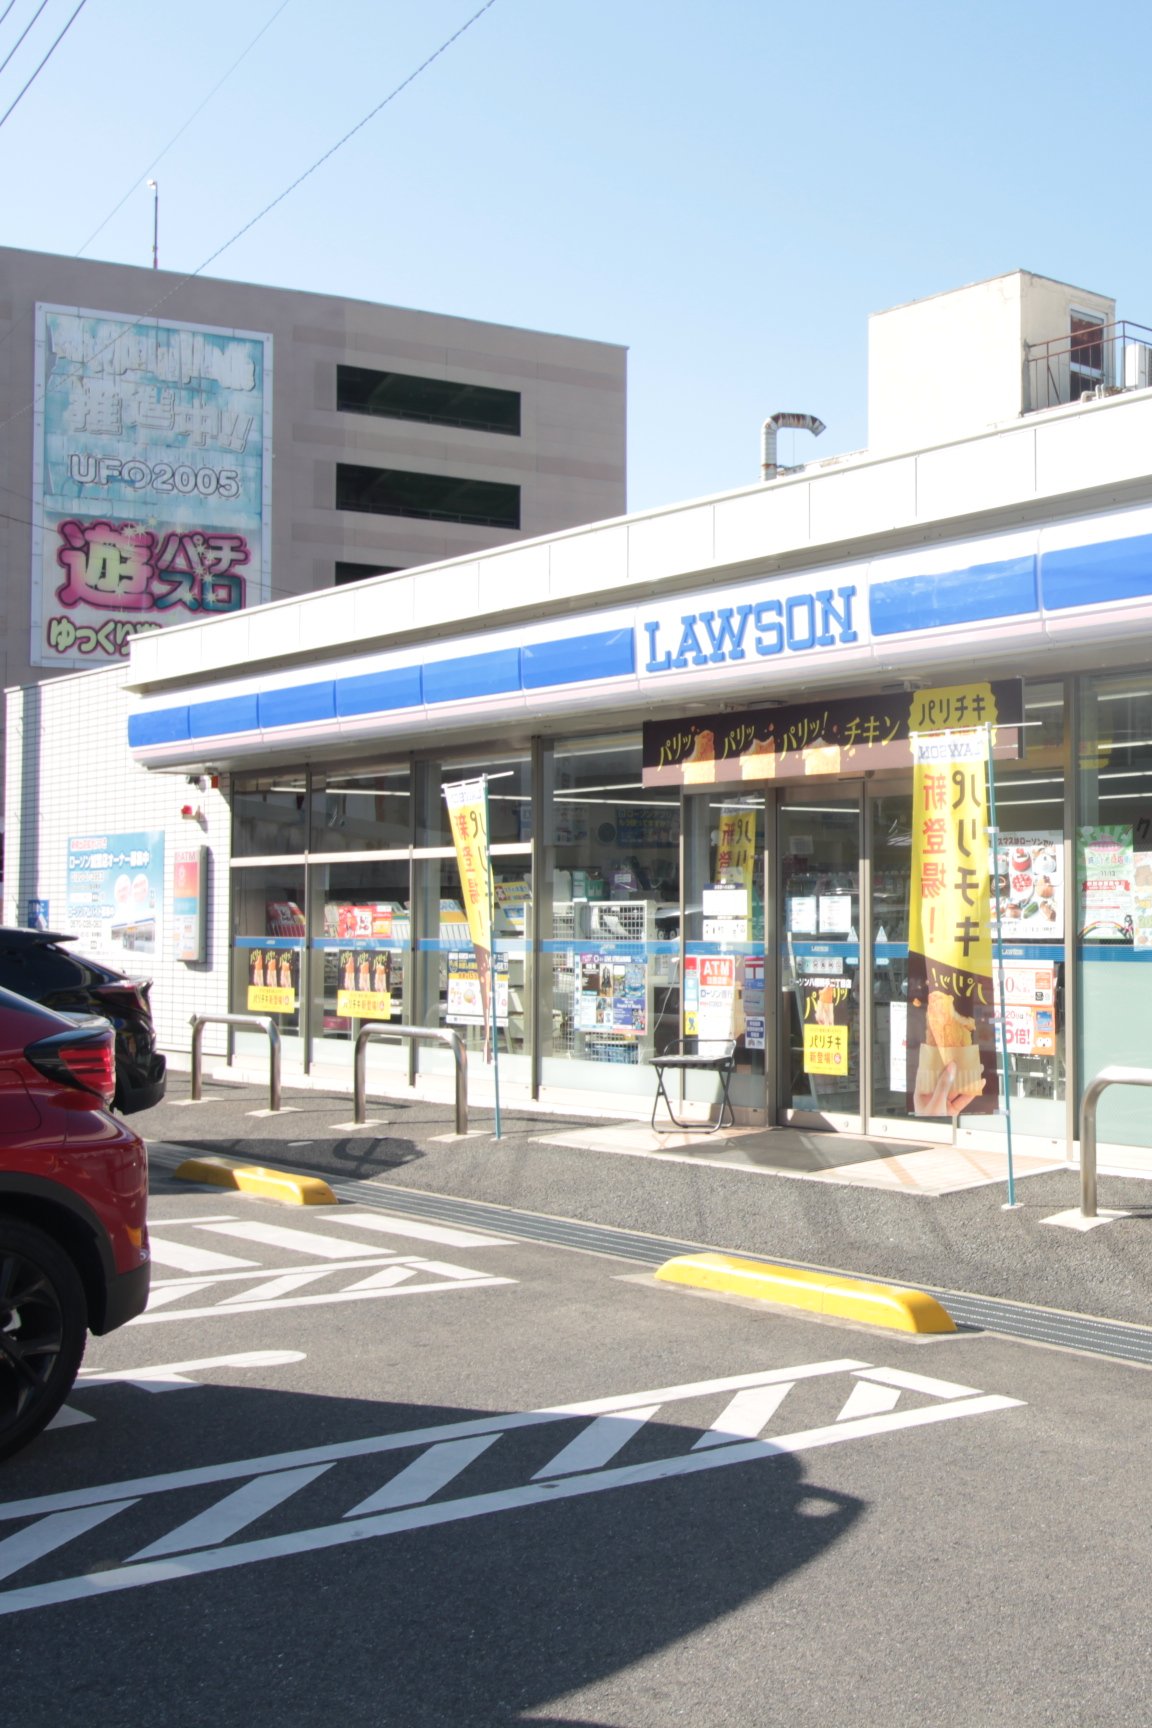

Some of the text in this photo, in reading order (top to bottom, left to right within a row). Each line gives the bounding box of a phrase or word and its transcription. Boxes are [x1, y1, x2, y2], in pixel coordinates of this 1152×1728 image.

[69, 453, 240, 498] UFO2005
[48, 616, 162, 656] ゆっくり
[644, 585, 858, 673] LAWSON
[918, 693, 987, 726] パリチキ
[844, 715, 900, 756] チキン
[703, 960, 730, 976] ATM
